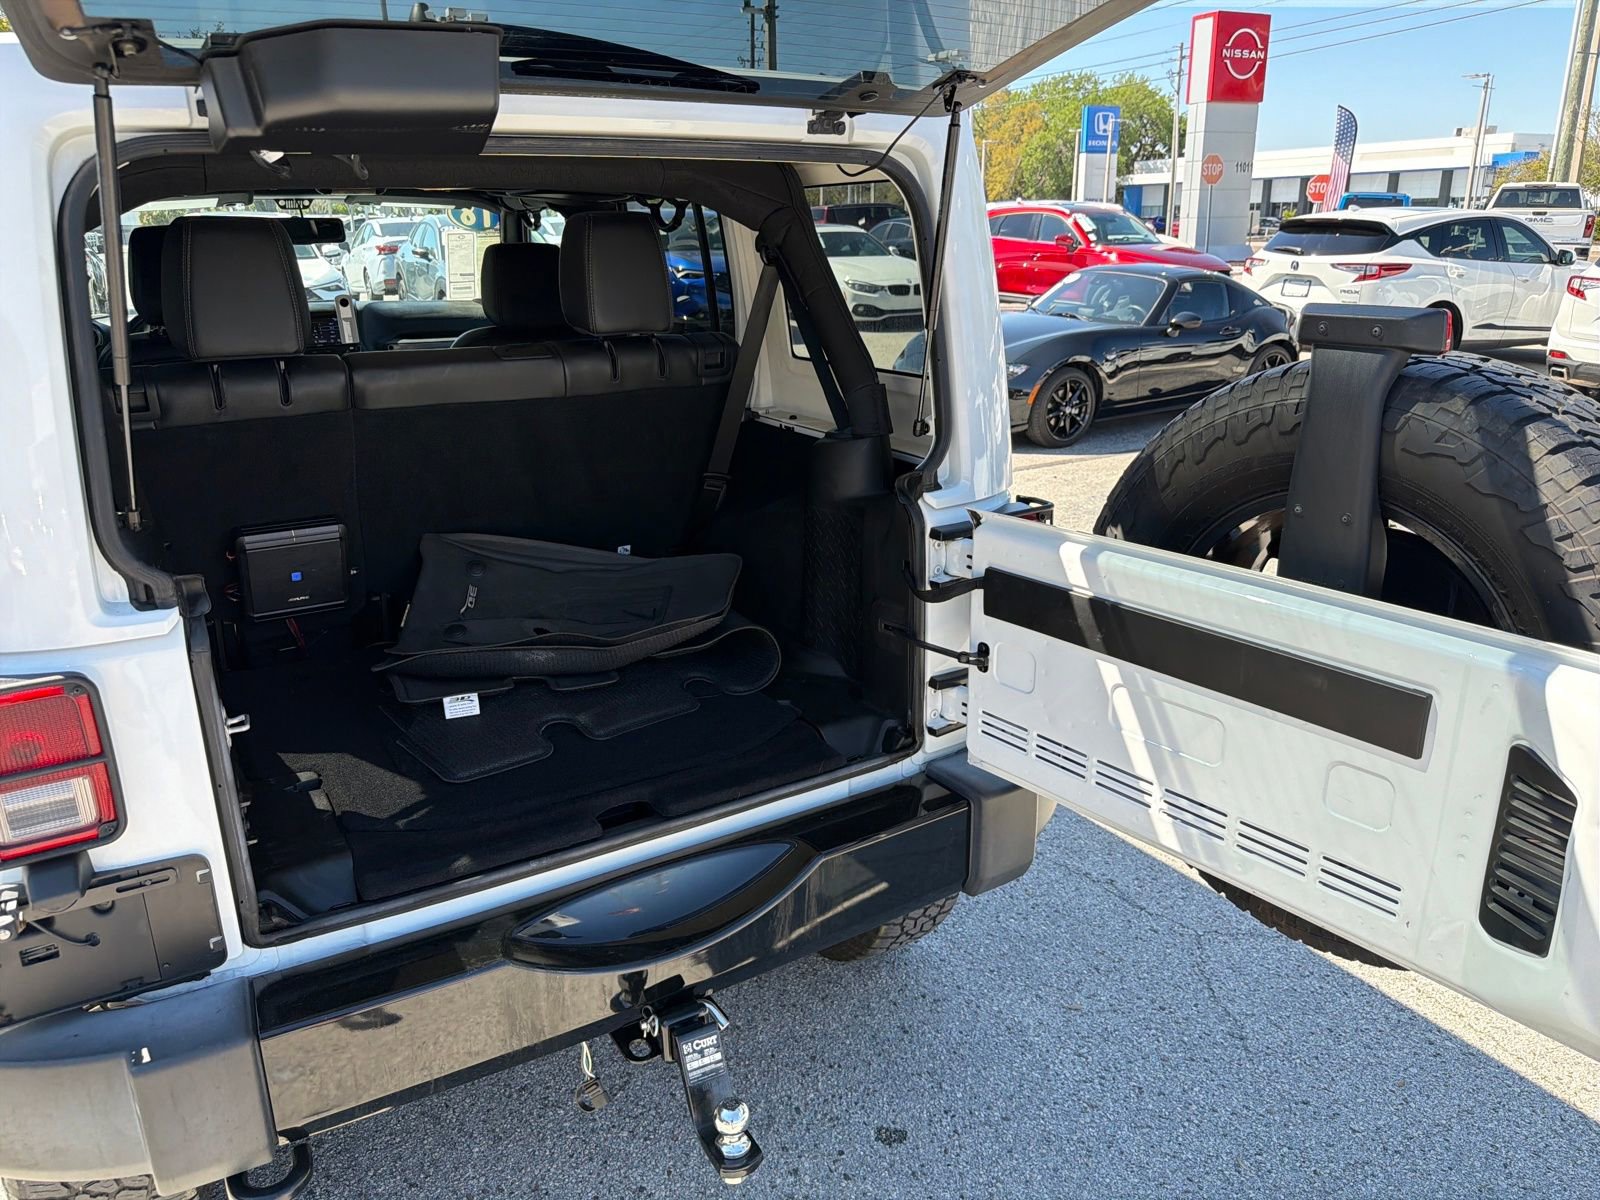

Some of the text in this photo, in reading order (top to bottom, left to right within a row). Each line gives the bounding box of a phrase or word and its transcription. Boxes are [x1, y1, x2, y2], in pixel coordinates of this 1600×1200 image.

[1222, 48, 1265, 59] NISSAN
[1202, 164, 1223, 176] STOP
[1309, 182, 1327, 194] STO
[693, 1034, 717, 1050] CURT
